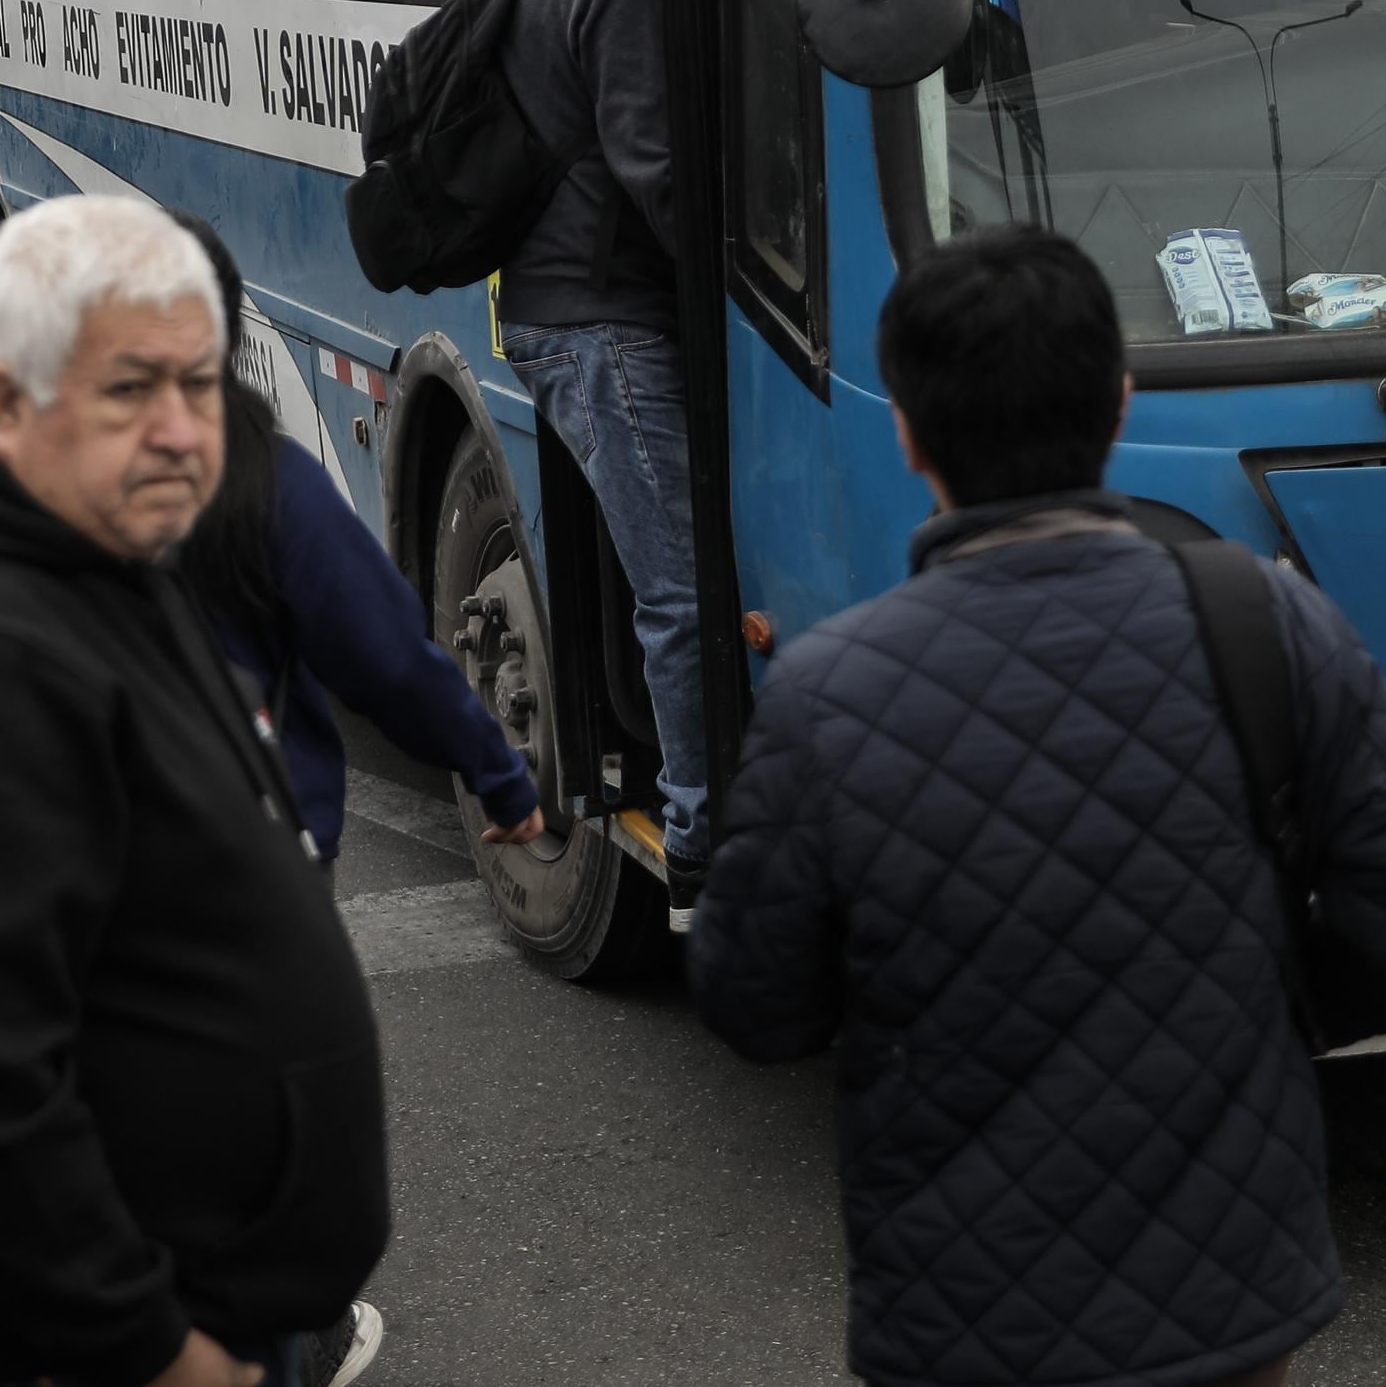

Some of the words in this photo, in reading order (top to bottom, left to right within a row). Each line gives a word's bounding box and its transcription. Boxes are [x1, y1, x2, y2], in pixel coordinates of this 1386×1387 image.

[21, 0, 47, 68] PRO
[62, 5, 100, 80] ACHO
[115, 11, 231, 107] EVITAMIENTO
[254, 27, 277, 115] V.
[280, 30, 401, 134] SALVAD
